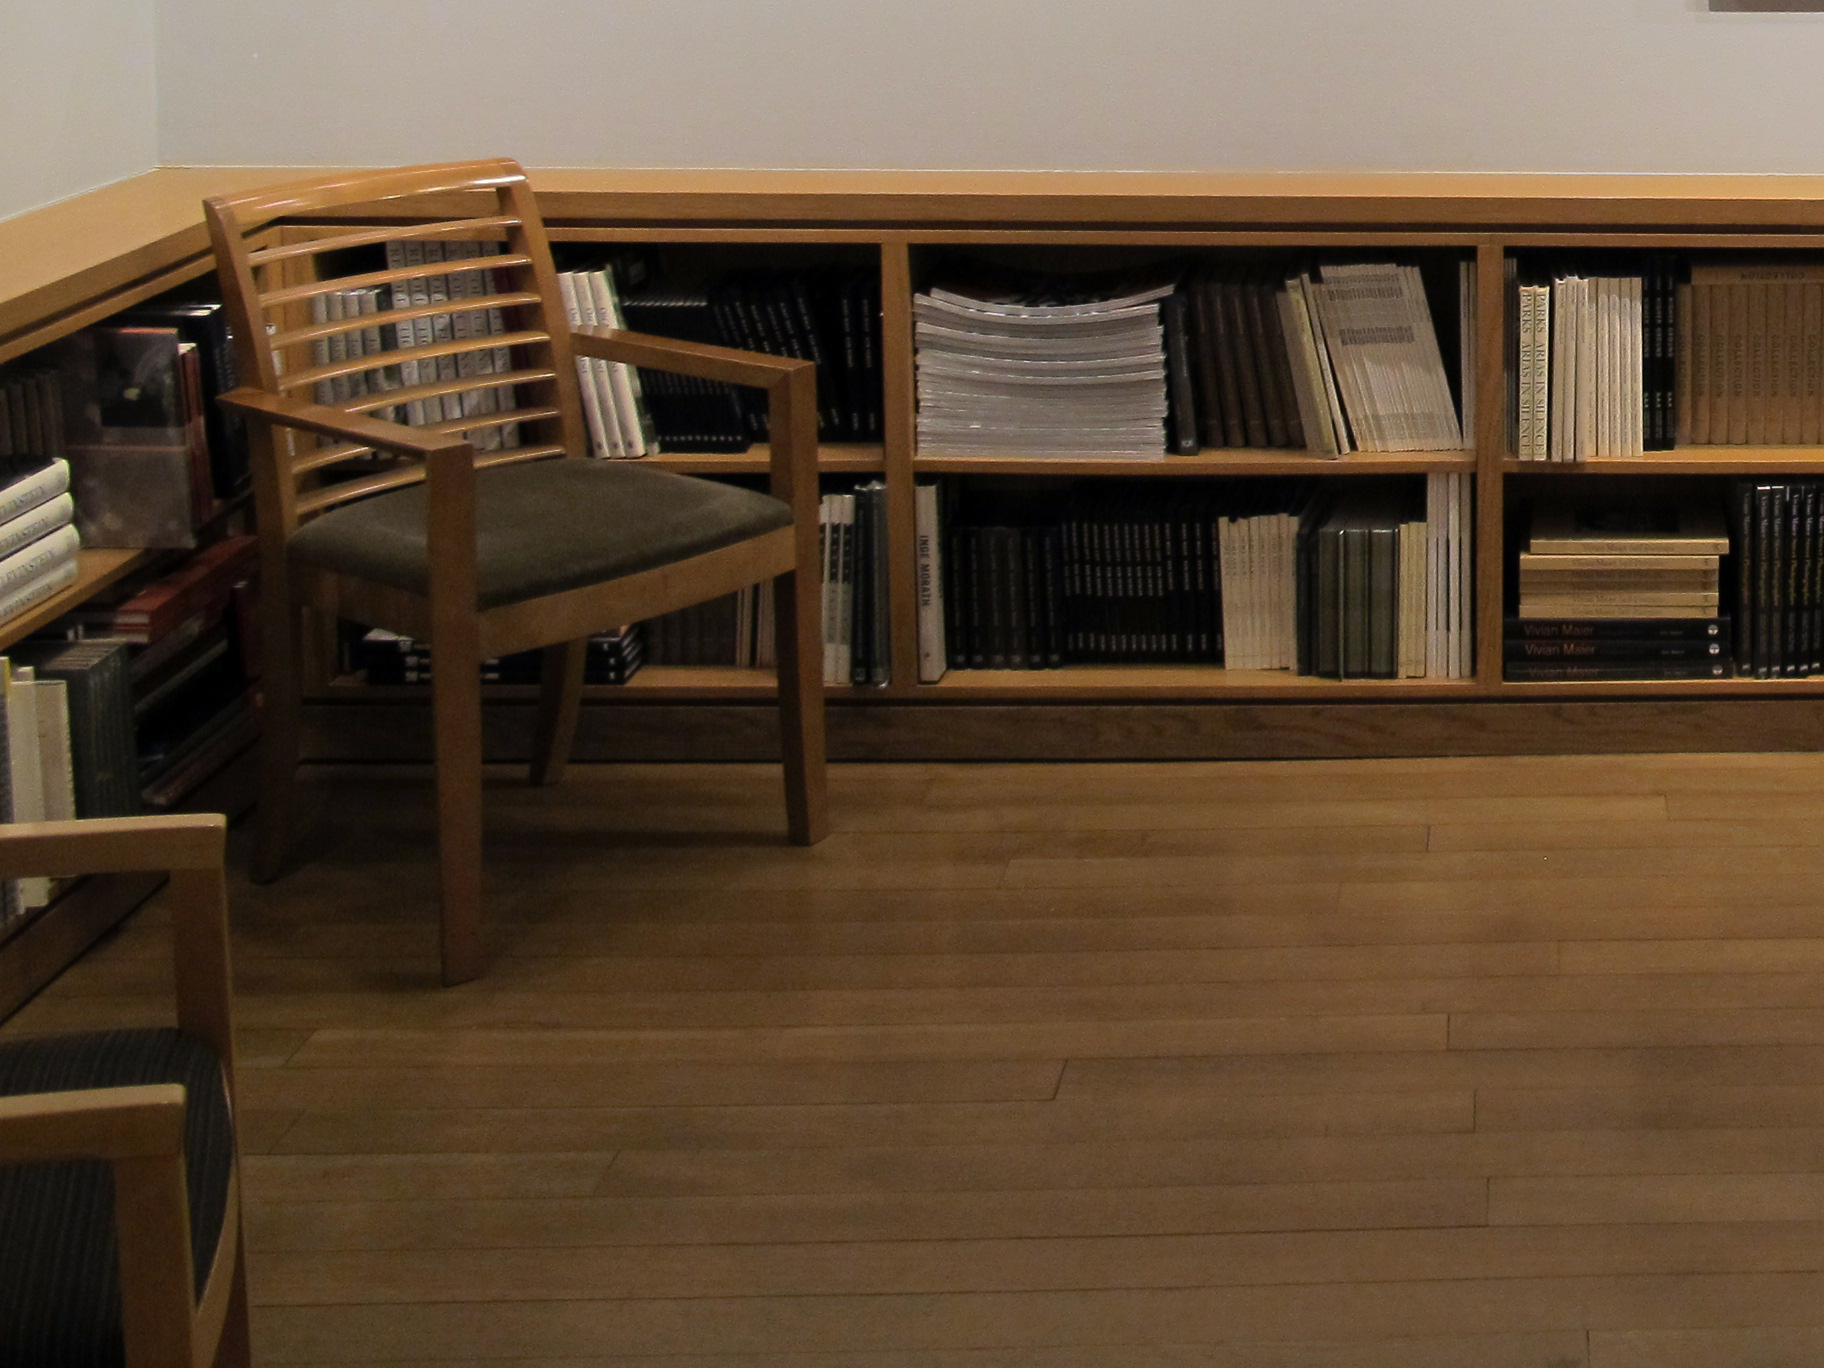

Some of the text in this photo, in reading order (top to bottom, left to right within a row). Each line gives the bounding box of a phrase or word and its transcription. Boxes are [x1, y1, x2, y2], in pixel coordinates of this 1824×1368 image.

[1521, 294, 1532, 450] PARKS ARIAS IN SILENCE
[1536, 294, 1546, 450] PARKS ARIAS IN SILENCE
[919, 536, 931, 606] INGE MORATH
[1524, 624, 1594, 636] Vivian Maier
[1525, 644, 1596, 655] Vivian Maier
